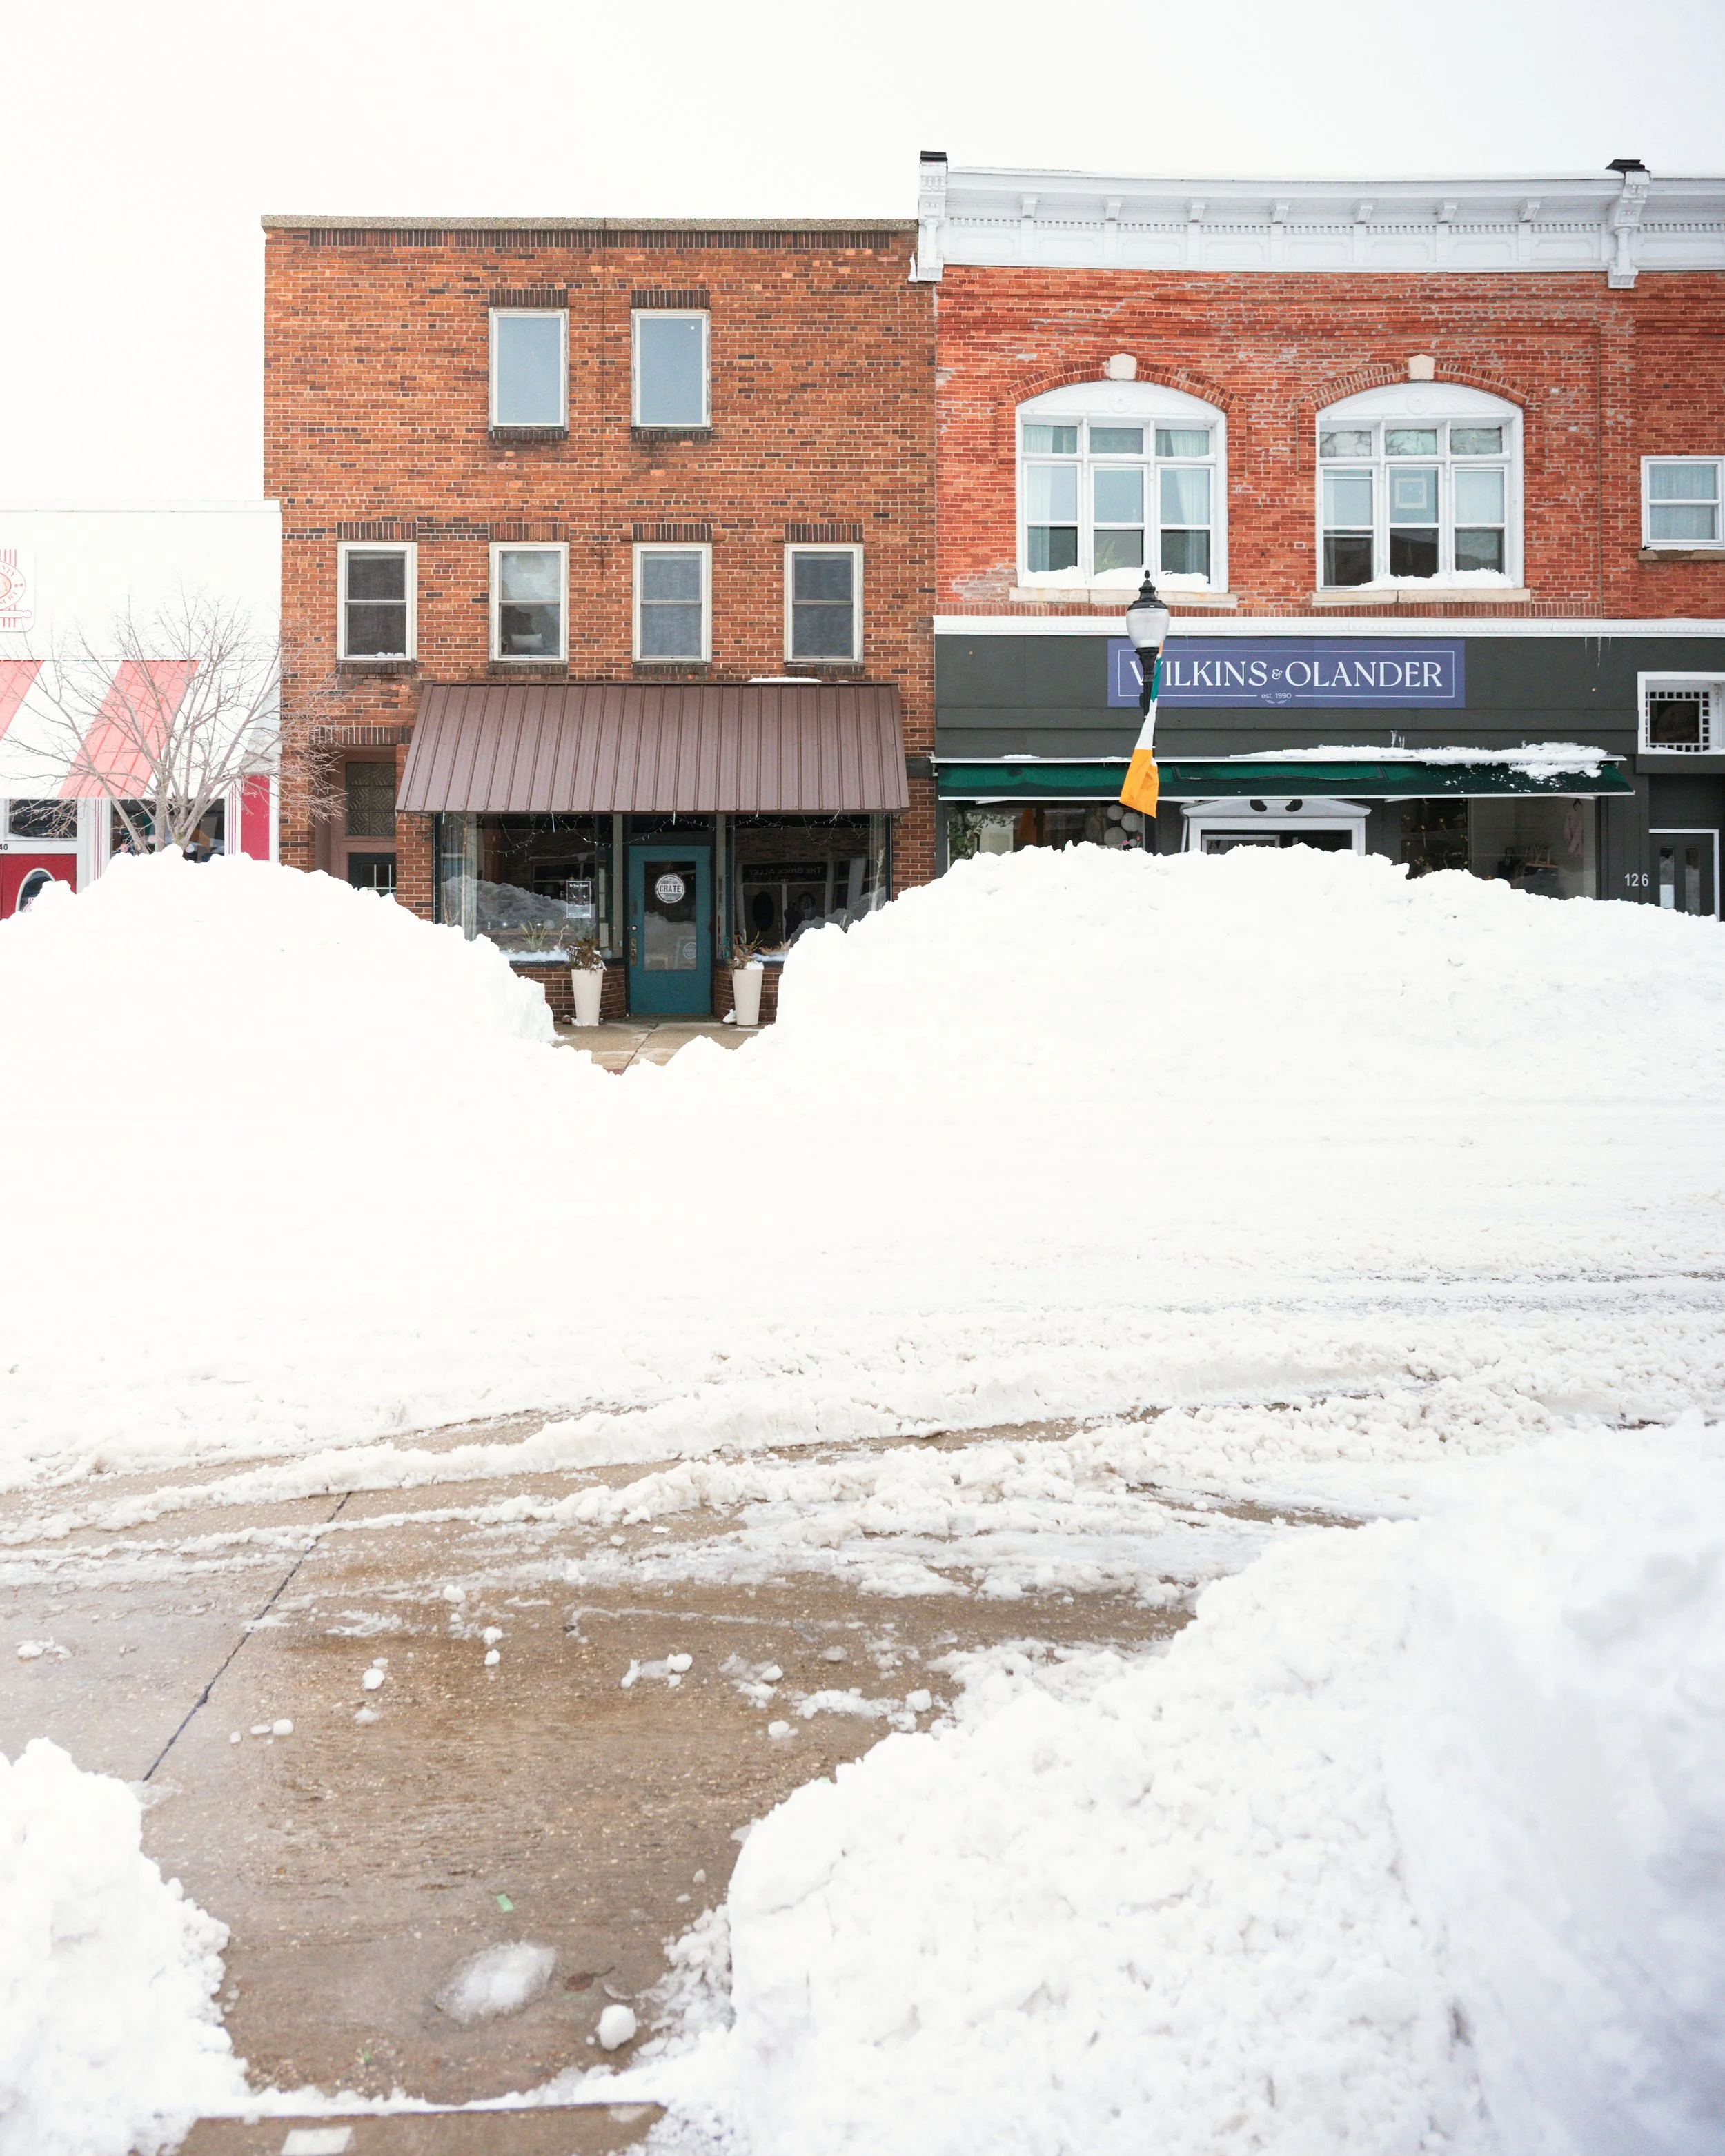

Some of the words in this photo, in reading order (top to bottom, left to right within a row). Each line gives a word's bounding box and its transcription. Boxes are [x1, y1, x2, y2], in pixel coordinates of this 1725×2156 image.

[1272, 669, 1283, 680] &
[1285, 661, 1443, 687] OLANDER
[1624, 873, 1649, 887] 126
[659, 884, 682, 893] CRATE
